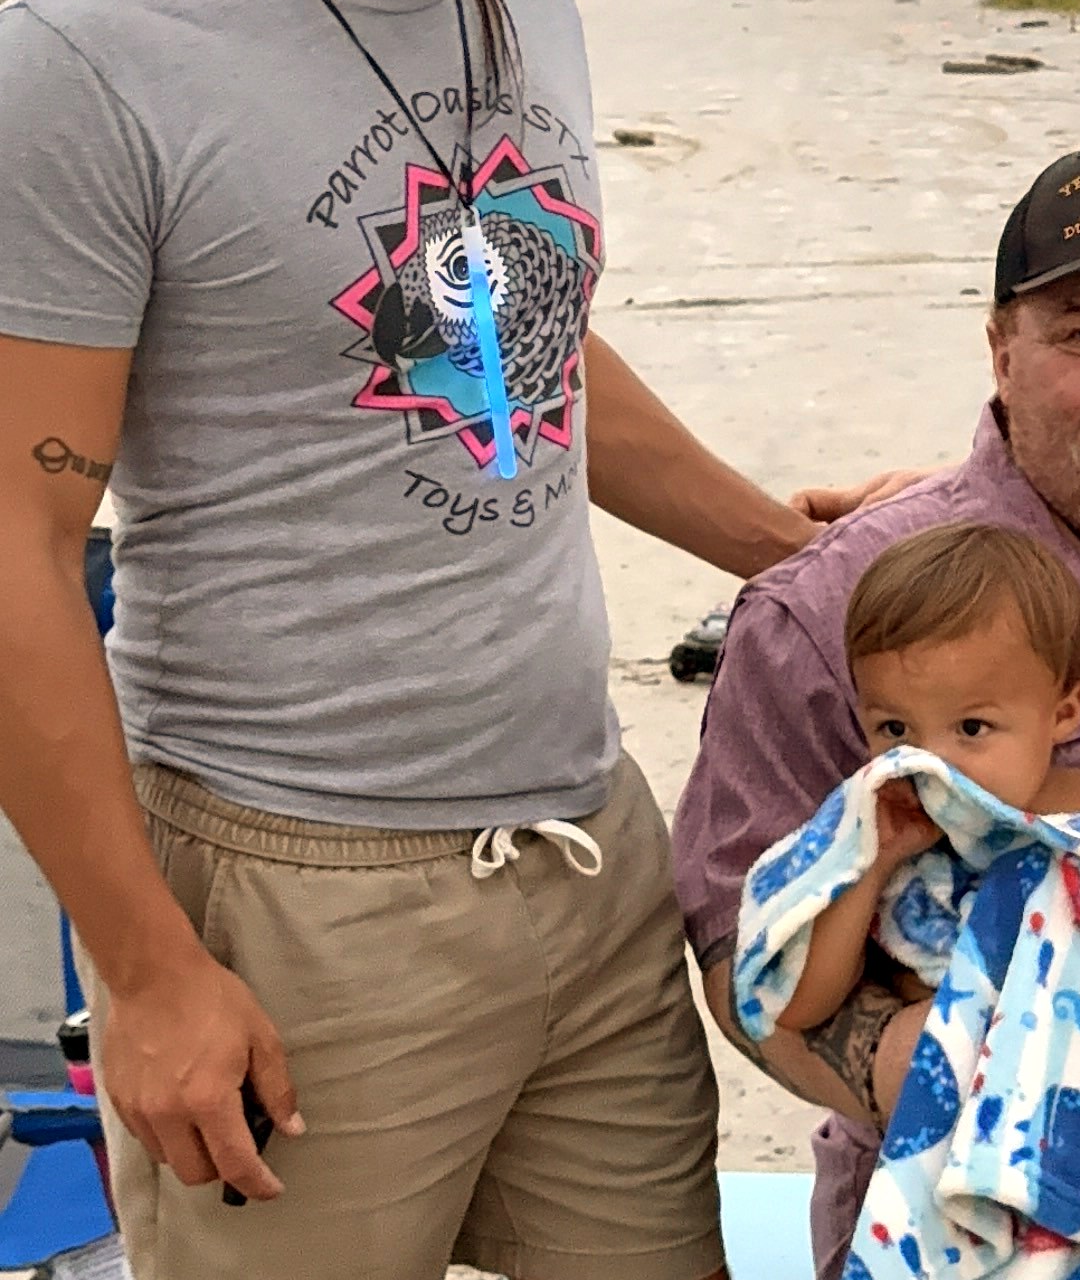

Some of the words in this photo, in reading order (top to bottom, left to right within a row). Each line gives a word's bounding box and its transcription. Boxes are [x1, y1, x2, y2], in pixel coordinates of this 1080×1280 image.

[306, 108, 409, 229] Parrot
[411, 86, 513, 122] Oasis
[403, 469, 499, 535] Toys
[510, 489, 535, 528] &
